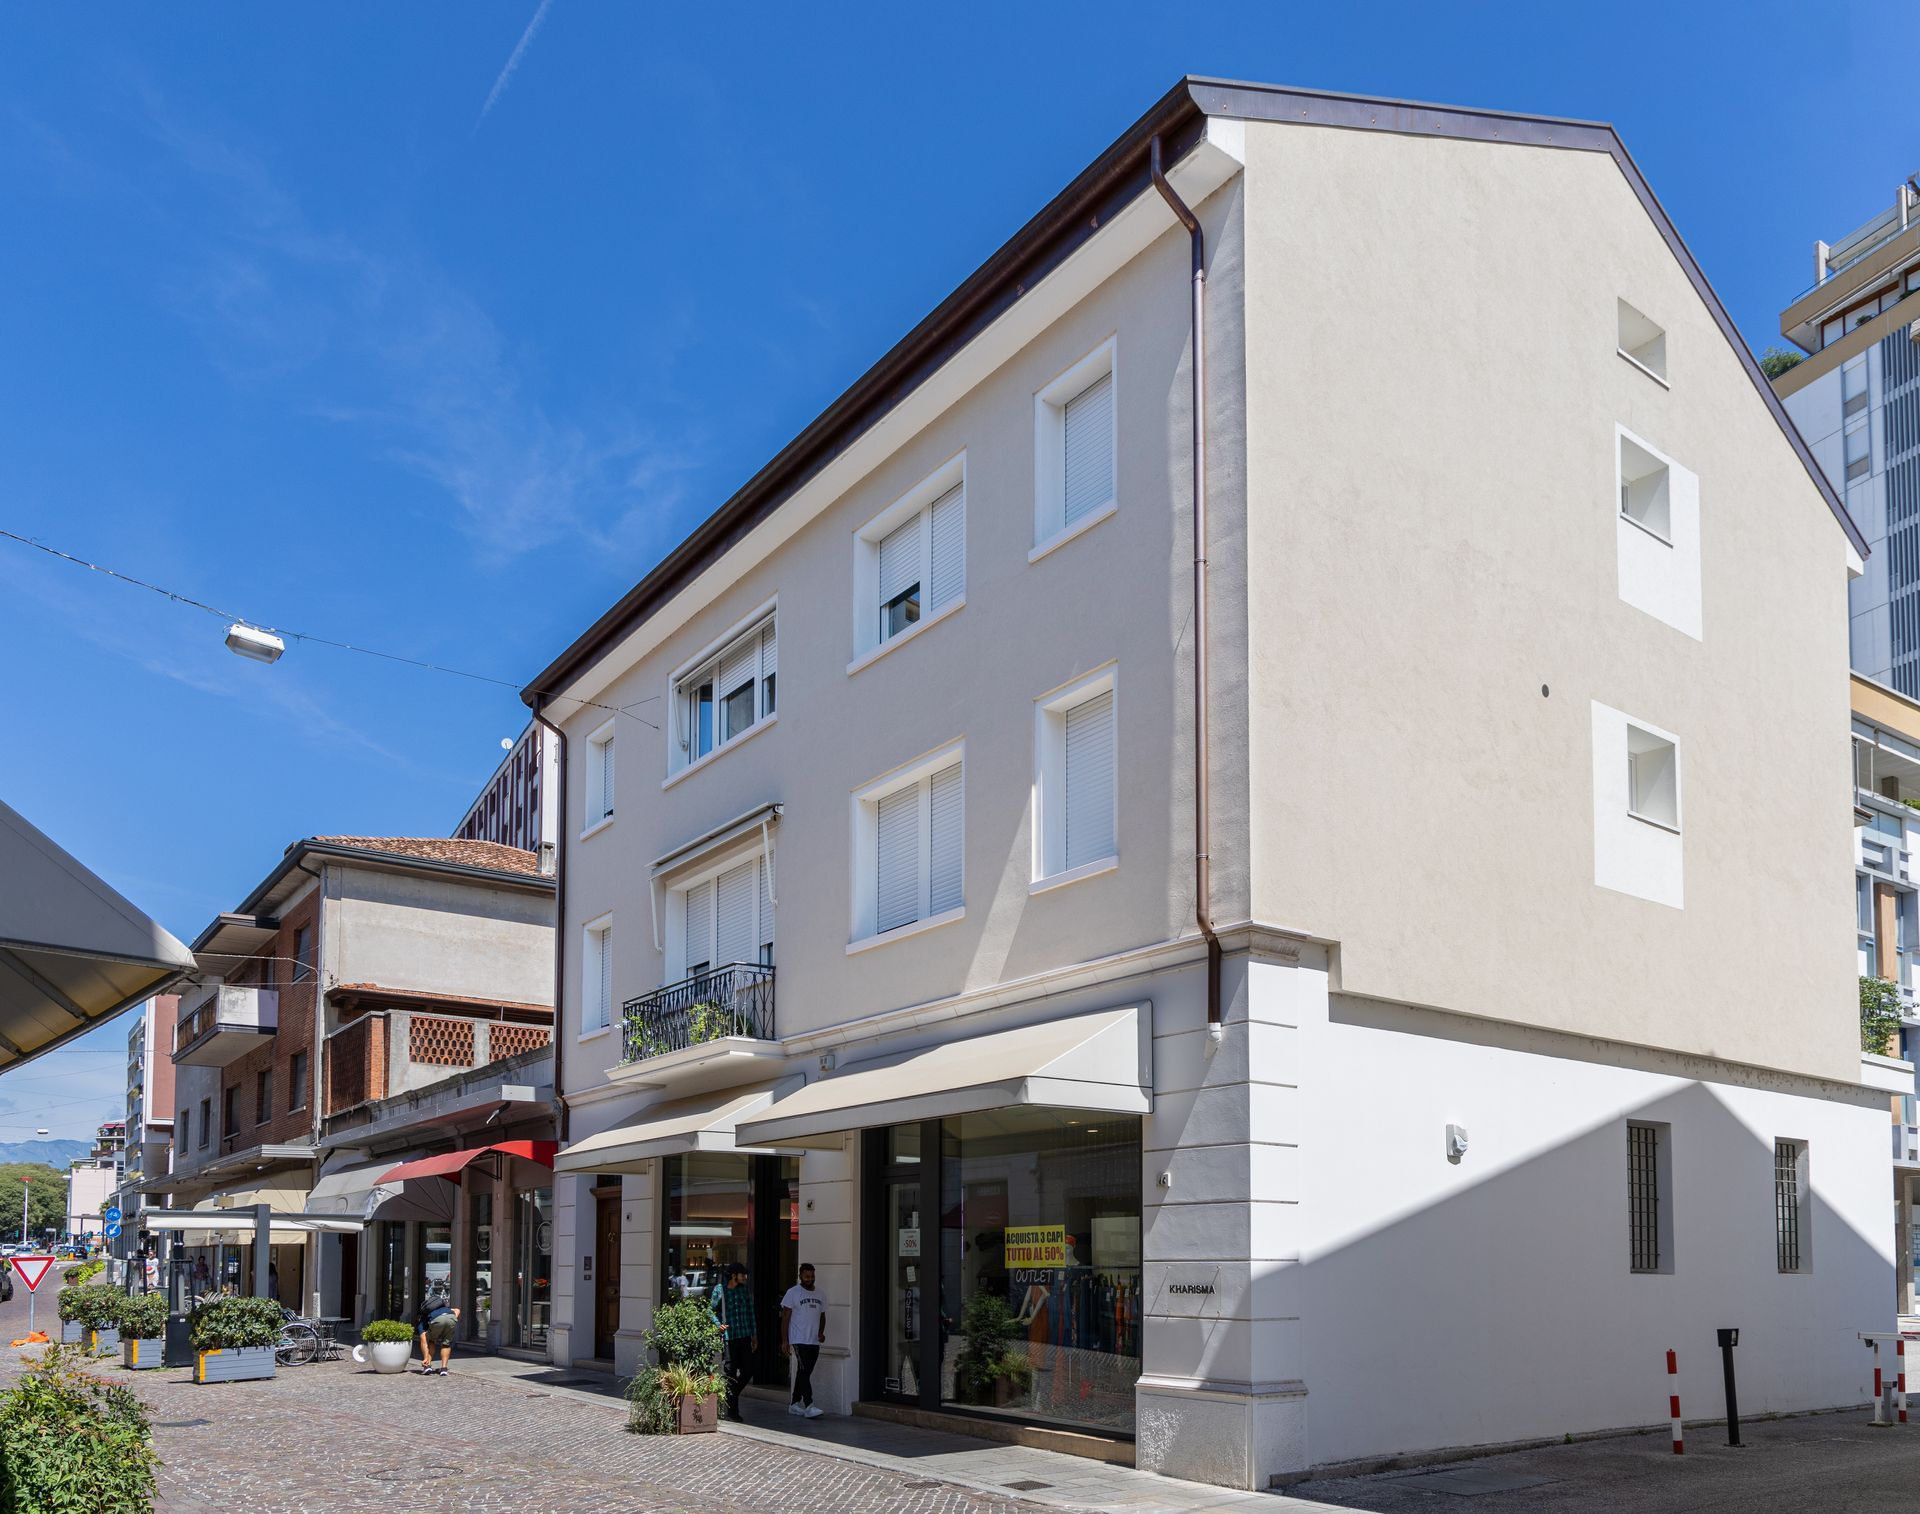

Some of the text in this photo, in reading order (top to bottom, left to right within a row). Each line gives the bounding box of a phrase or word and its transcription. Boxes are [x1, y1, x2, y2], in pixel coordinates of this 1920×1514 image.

[1006, 1231, 1063, 1244] ACQUISTA 3 CAPI
[1006, 1246, 1064, 1261] TUTTO AL 50%
[1015, 1269, 1053, 1283] OUTLET
[1169, 1284, 1216, 1294] KHARISMA
